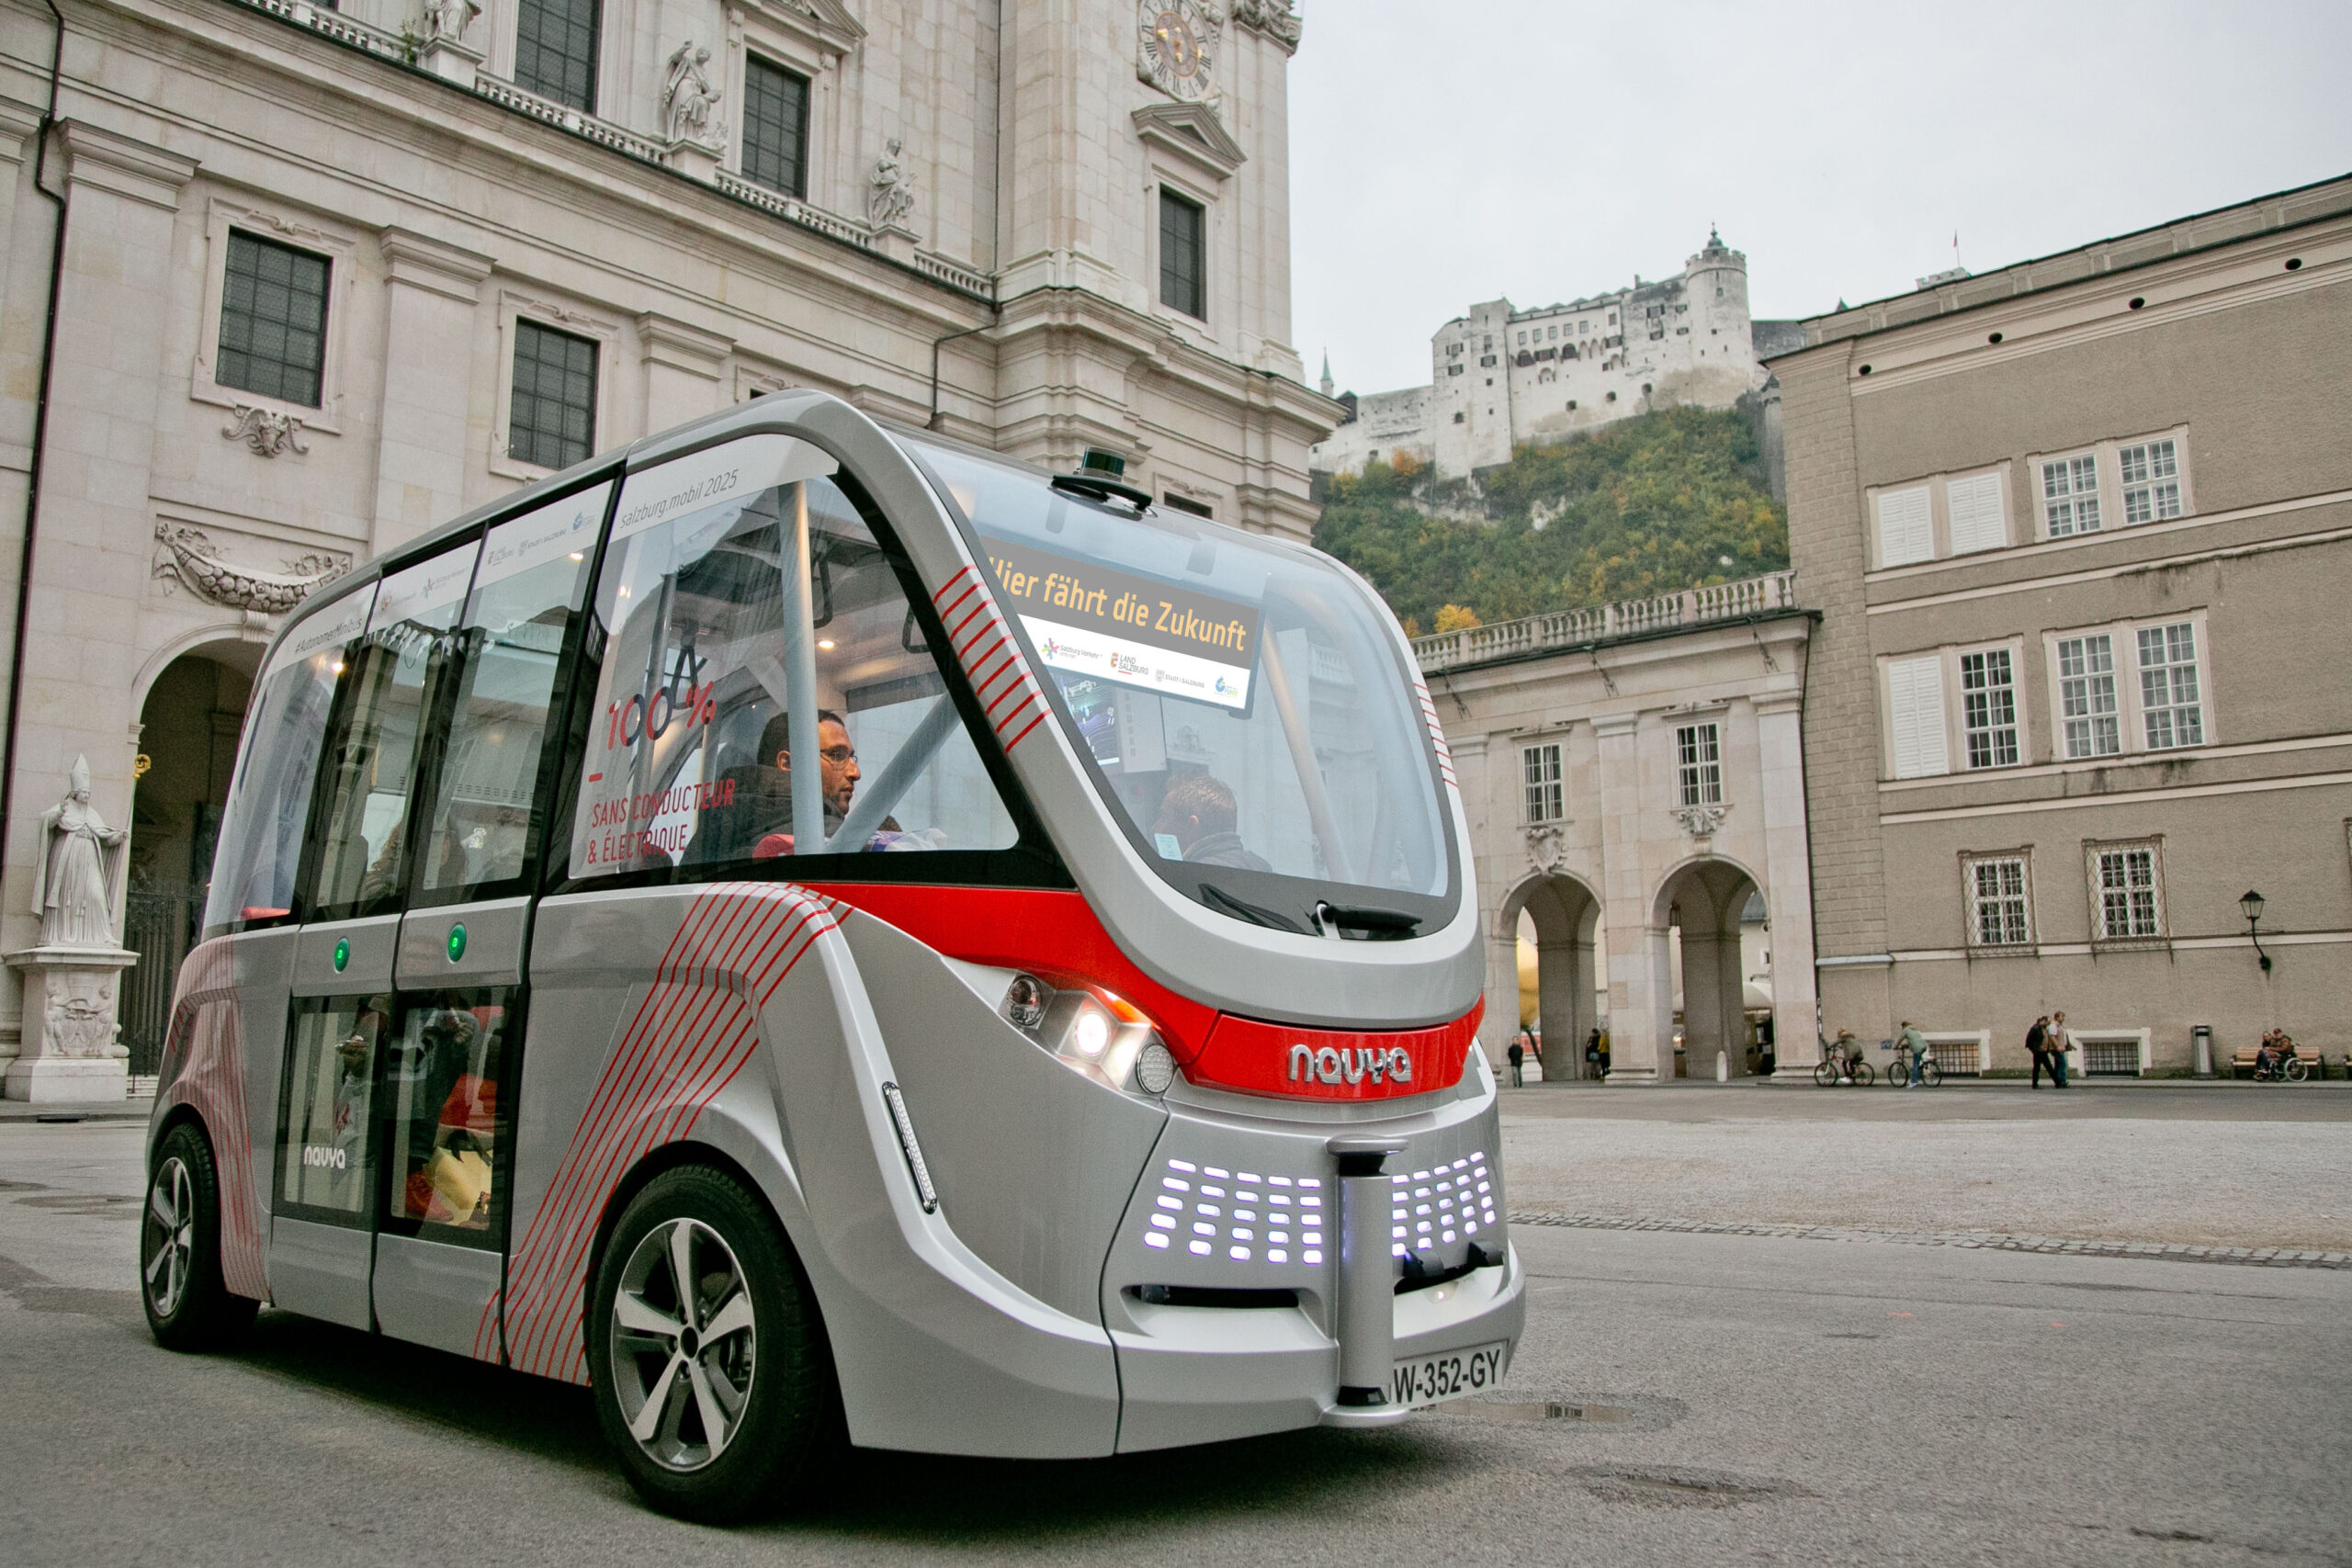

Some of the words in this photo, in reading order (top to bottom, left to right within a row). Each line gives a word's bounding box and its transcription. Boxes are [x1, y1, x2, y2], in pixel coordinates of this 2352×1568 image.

[619, 480, 704, 529] salzburg.mobil
[704, 468, 739, 498] 2025
[1044, 572, 1108, 616] fährt
[1113, 592, 1148, 626] die
[1155, 601, 1247, 651] Zukunft
[1118, 661, 1149, 676] SALZBURG
[1120, 654, 1136, 665] LAND
[592, 797, 628, 828] SANS
[631, 778, 736, 822] CONDUCTEUR
[587, 839, 597, 864] &
